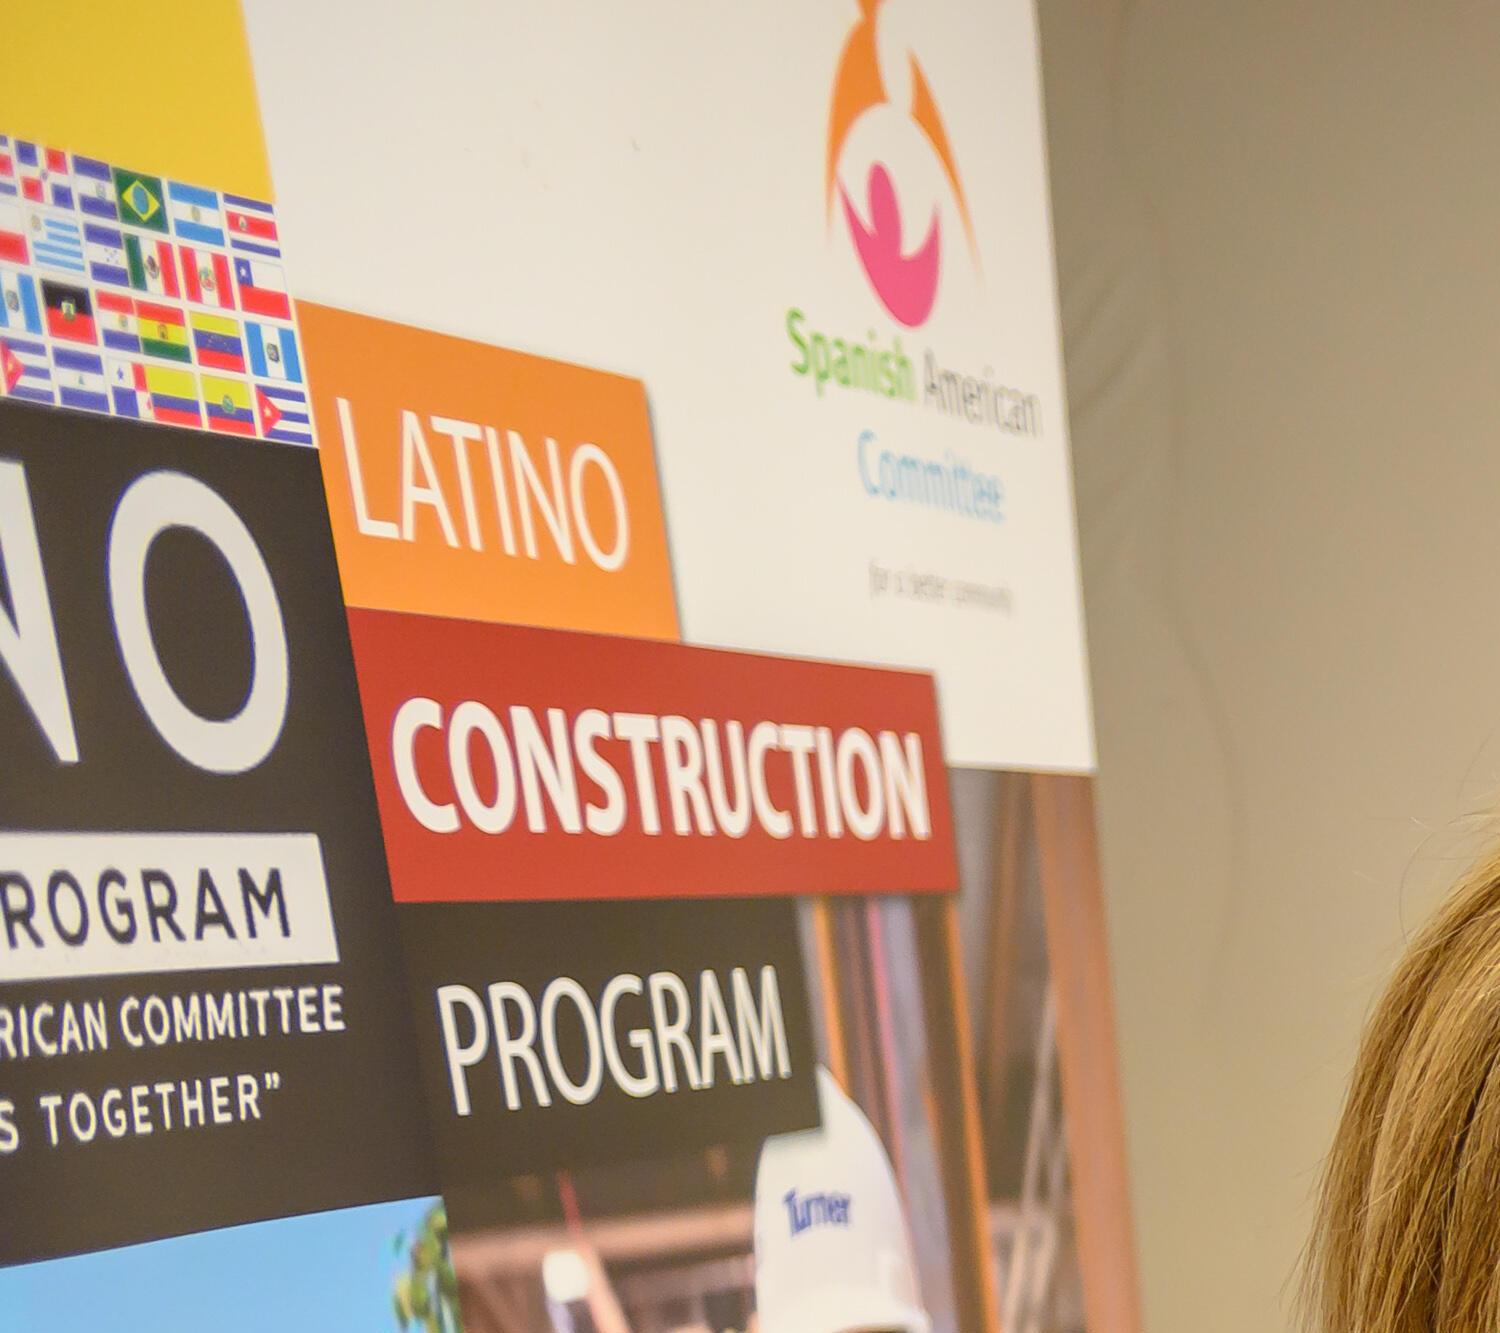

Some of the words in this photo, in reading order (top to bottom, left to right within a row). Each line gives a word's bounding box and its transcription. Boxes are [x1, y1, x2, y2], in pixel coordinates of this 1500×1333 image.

[785, 307, 916, 400] Spanish
[924, 347, 1042, 440] American
[336, 398, 631, 573] LATINO
[857, 428, 1004, 524] Committee
[391, 696, 932, 841] CONSTRUCTION
[120, 984, 347, 1048] COMMITTEE
[437, 965, 792, 1118] PROGRAM
